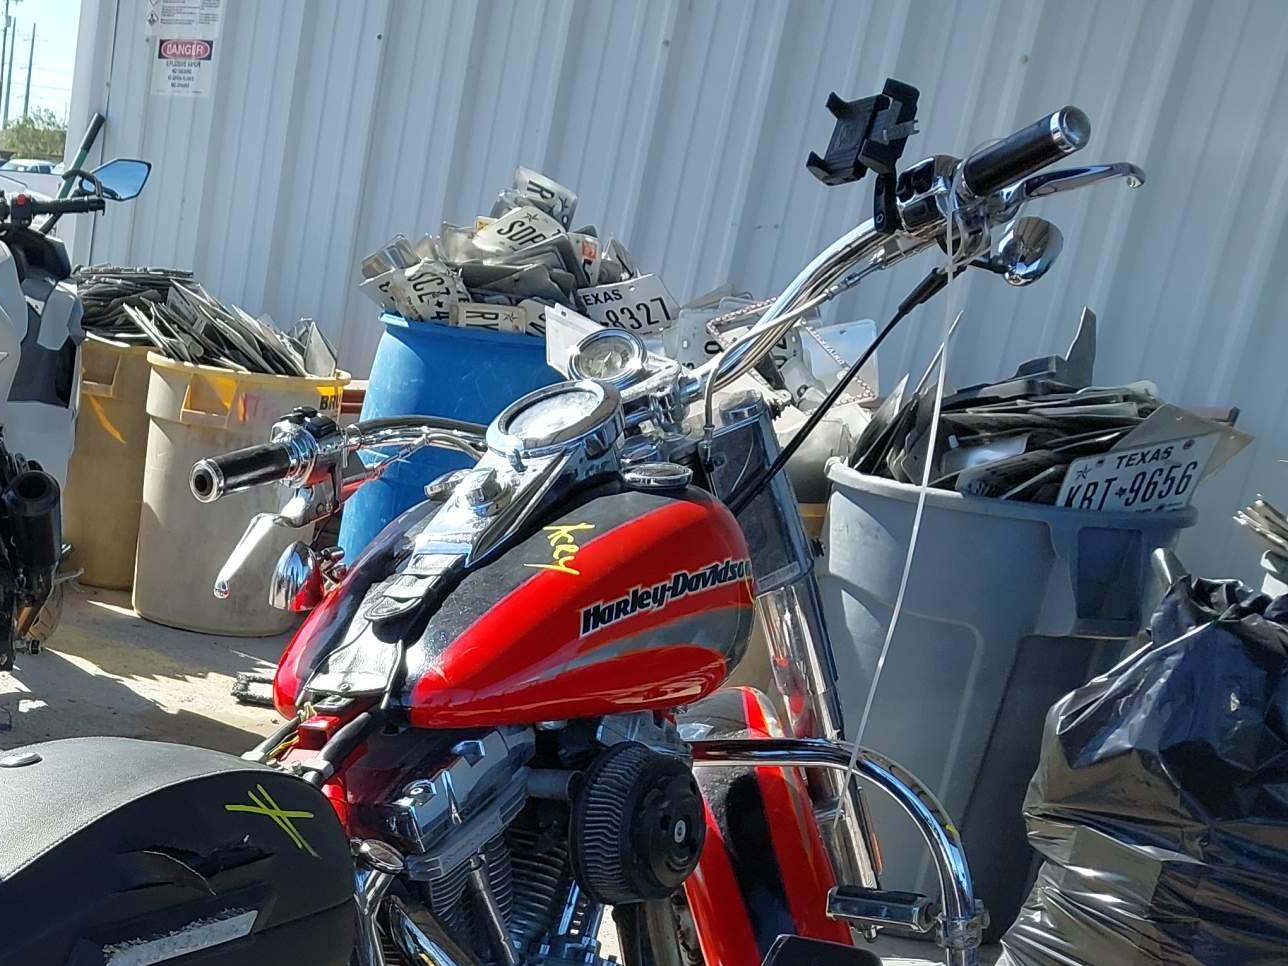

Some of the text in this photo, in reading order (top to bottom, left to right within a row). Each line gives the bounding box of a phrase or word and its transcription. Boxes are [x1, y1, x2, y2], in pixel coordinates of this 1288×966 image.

[166, 43, 205, 56] DANGER
[582, 289, 623, 306] EXAS
[1116, 446, 1173, 469] TEXAS
[580, 558, 752, 637] Harley-Davidson
